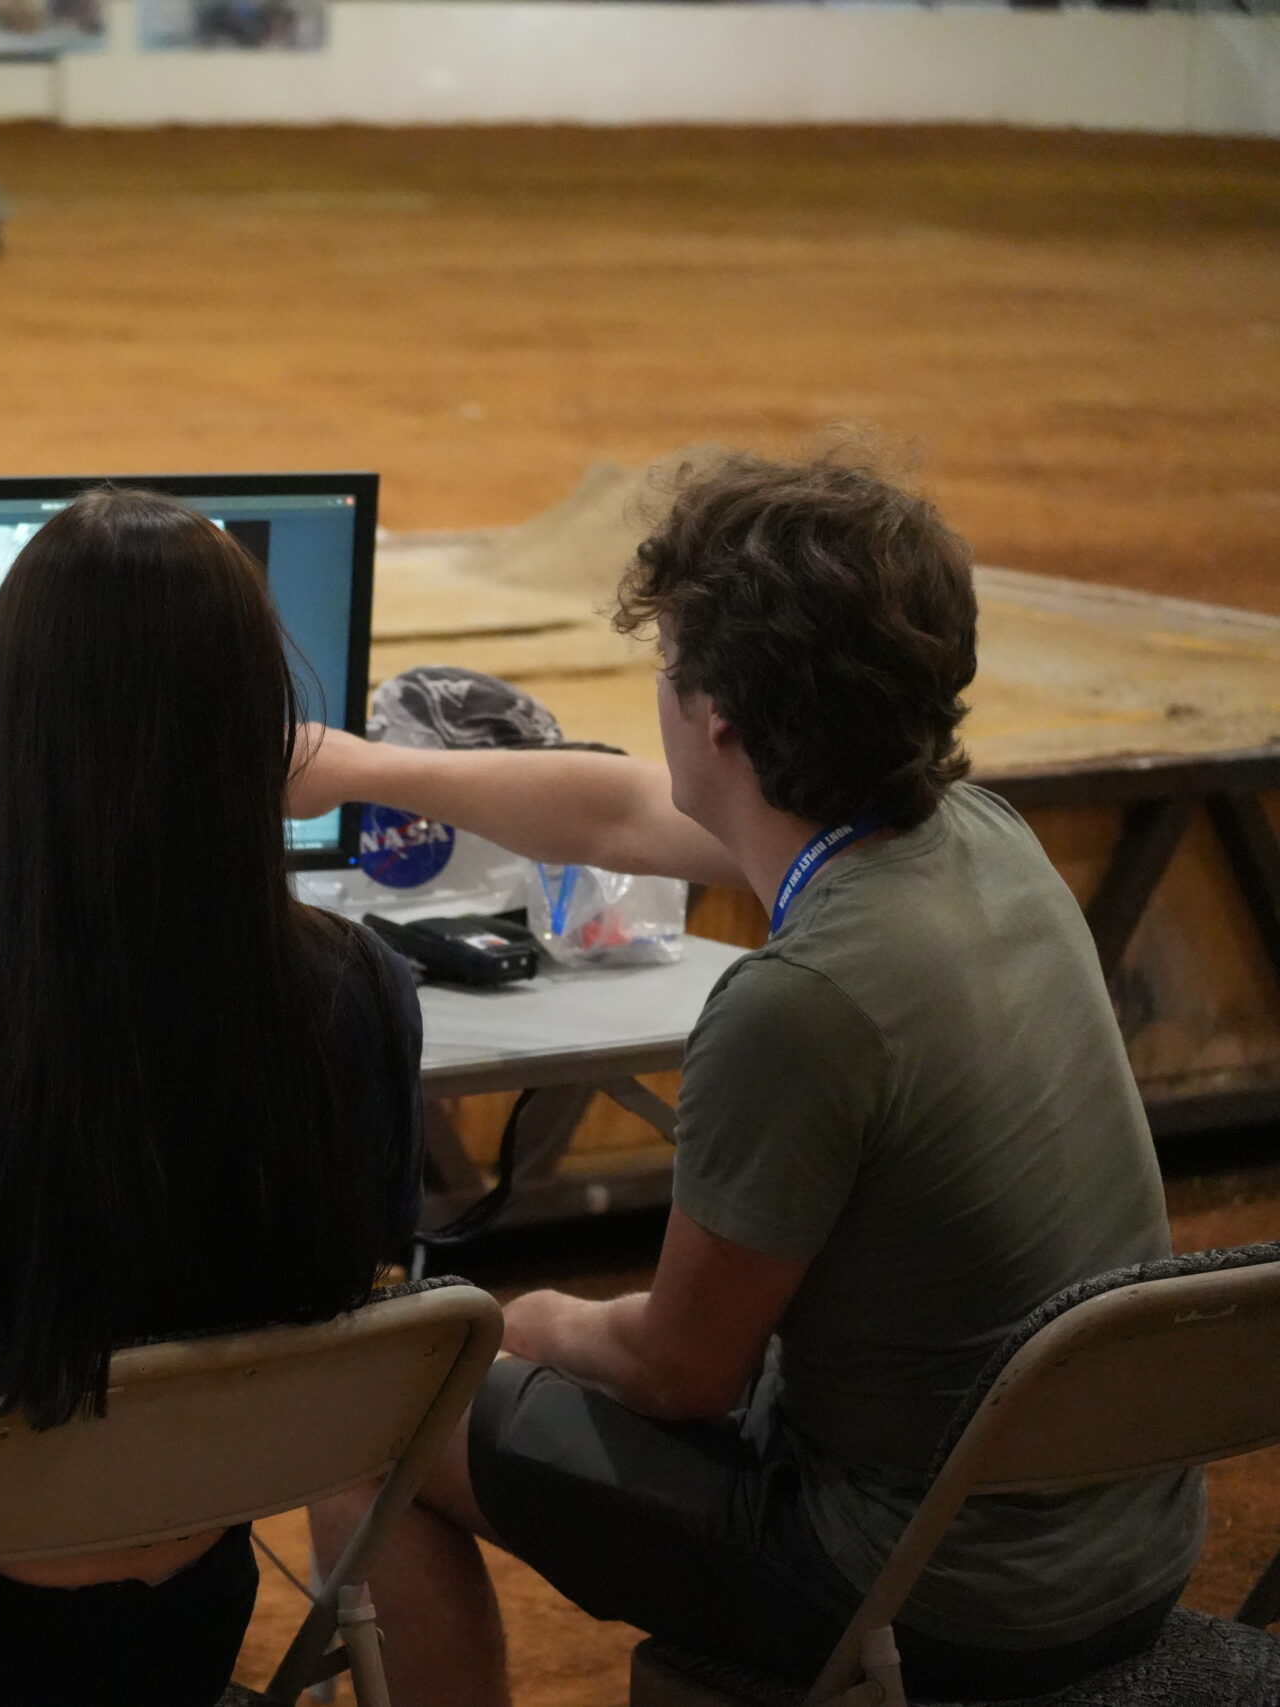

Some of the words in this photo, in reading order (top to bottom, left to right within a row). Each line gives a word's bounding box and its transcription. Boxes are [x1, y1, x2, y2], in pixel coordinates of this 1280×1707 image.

[360, 820, 450, 854] NASA
[824, 824, 853, 846] MONT
[798, 840, 827, 872] RIPLEY
[788, 868, 802, 888] SKI
[778, 883, 793, 909] AREA
